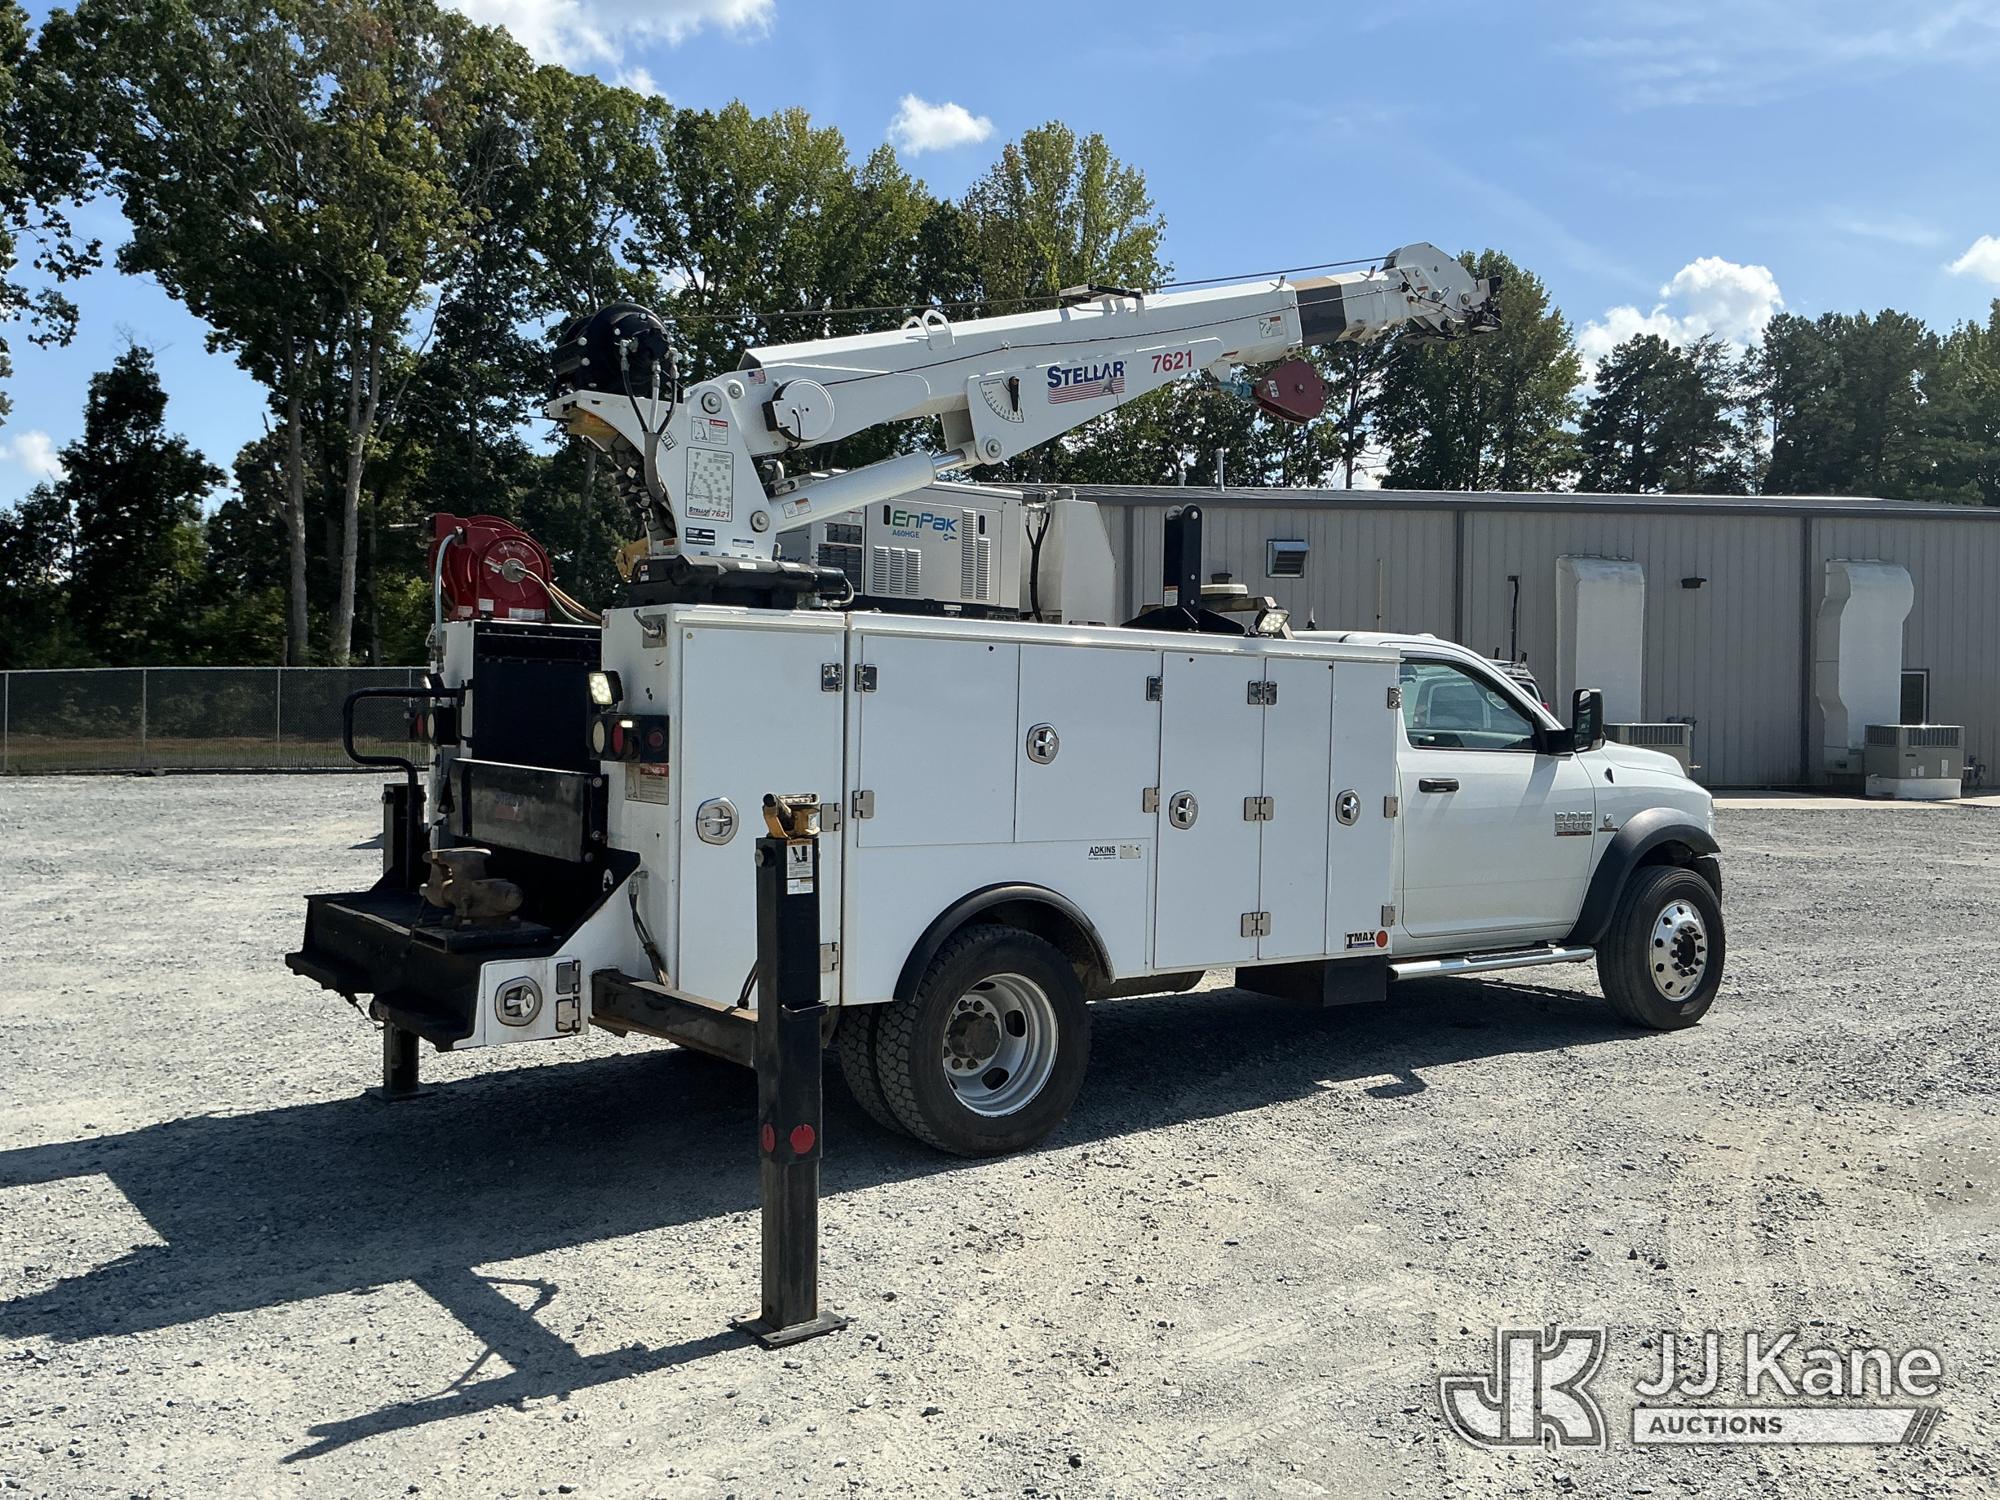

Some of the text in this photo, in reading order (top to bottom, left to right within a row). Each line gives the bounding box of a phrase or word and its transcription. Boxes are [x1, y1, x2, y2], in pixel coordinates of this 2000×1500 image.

[1047, 349, 1193, 389] STELLAR 7621
[892, 510, 959, 532] EnPak
[1088, 845, 1116, 856] ADKINS
[1346, 931, 1375, 949] TMAX
